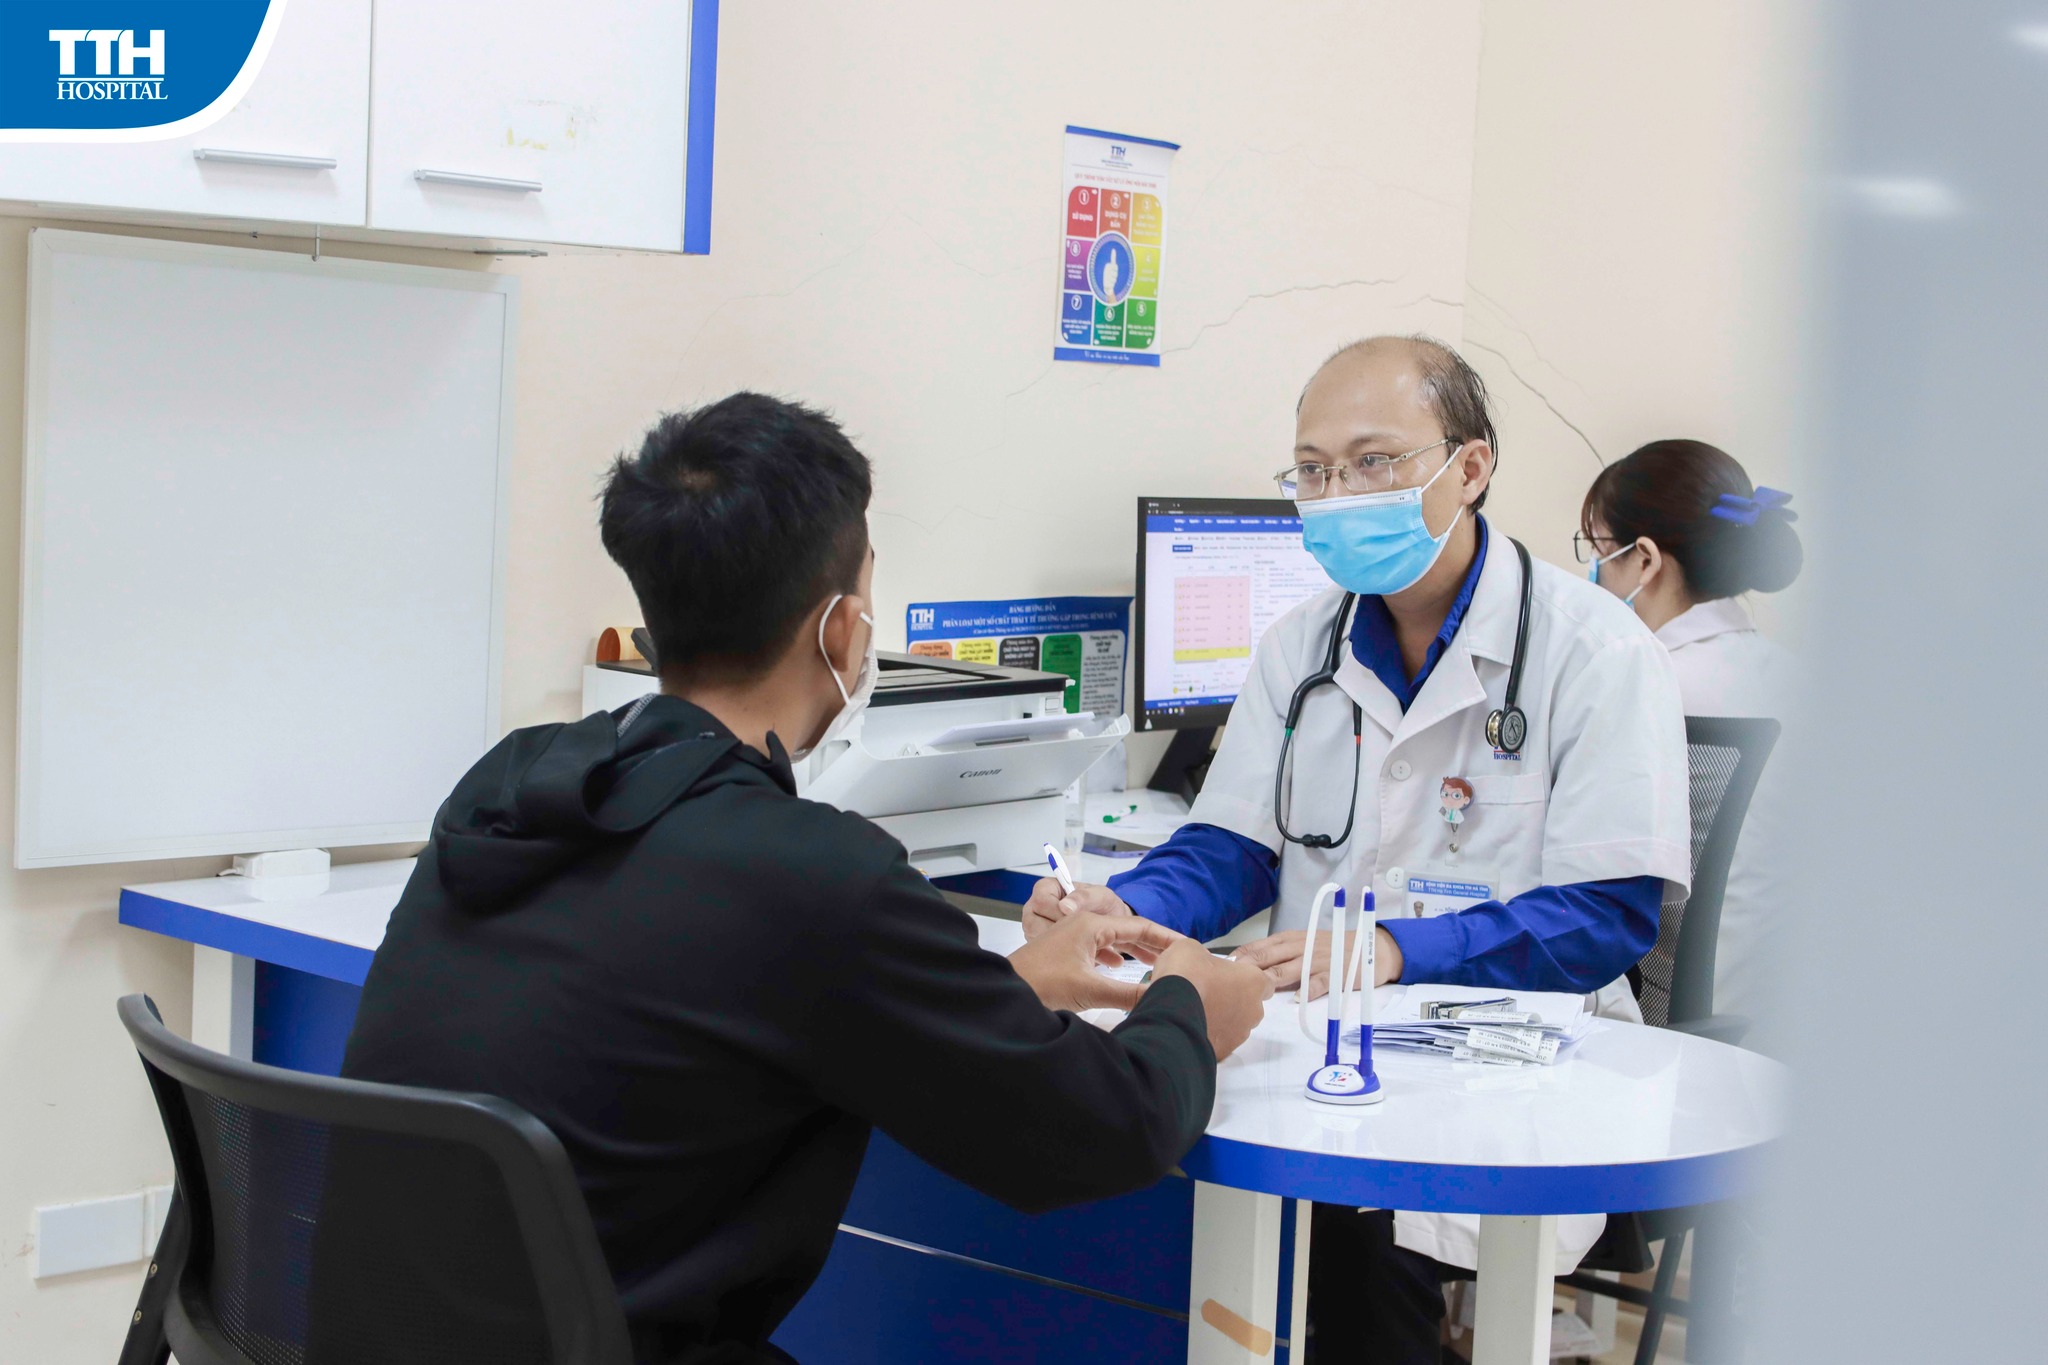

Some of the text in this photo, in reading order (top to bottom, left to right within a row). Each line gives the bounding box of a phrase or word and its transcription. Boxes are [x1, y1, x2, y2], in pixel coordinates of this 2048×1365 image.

[1111, 145, 1126, 156] TTH
[910, 608, 934, 623] TTH
[911, 623, 934, 631] HOSPITAL
[1493, 752, 1521, 761] HOSPITAL
[959, 768, 1002, 779] Canon
[1410, 880, 1424, 888] TTH
